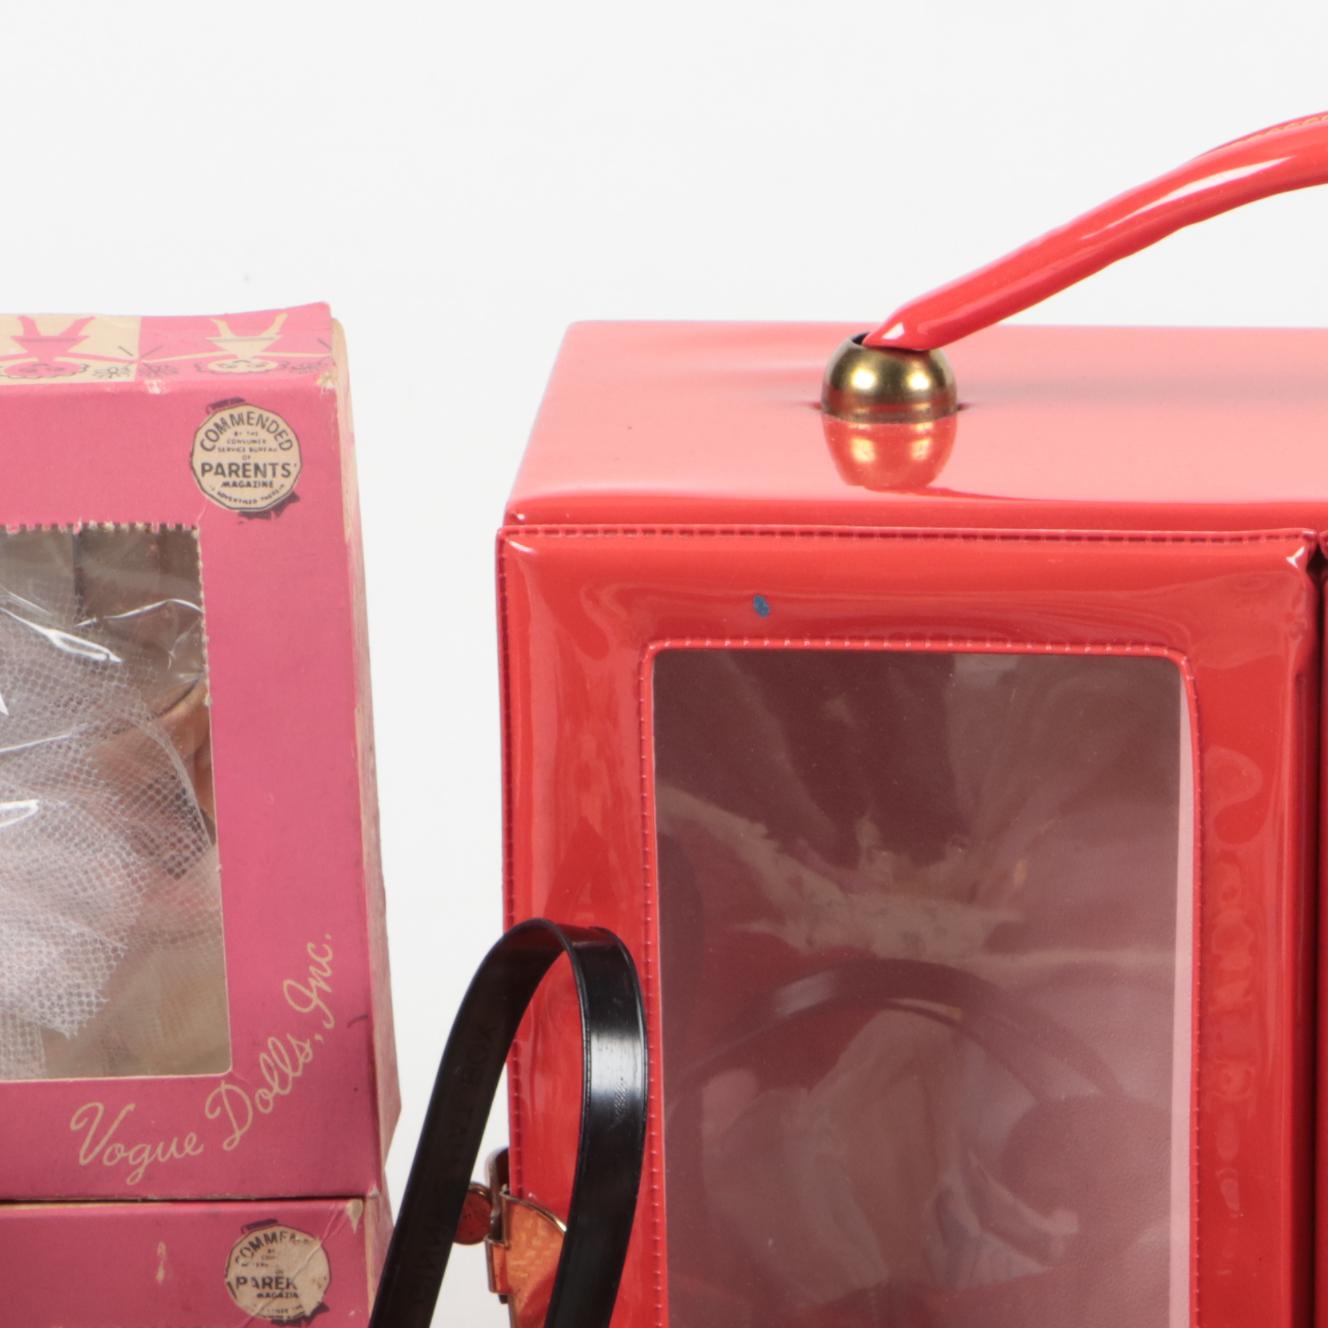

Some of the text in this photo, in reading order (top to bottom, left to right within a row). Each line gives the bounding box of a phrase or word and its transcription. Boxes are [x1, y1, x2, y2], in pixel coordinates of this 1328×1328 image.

[200, 411, 293, 452] COMMENDED
[220, 480, 275, 489] MAGAZINE
[69, 931, 338, 1186] Vogue Dolls, Inc.
